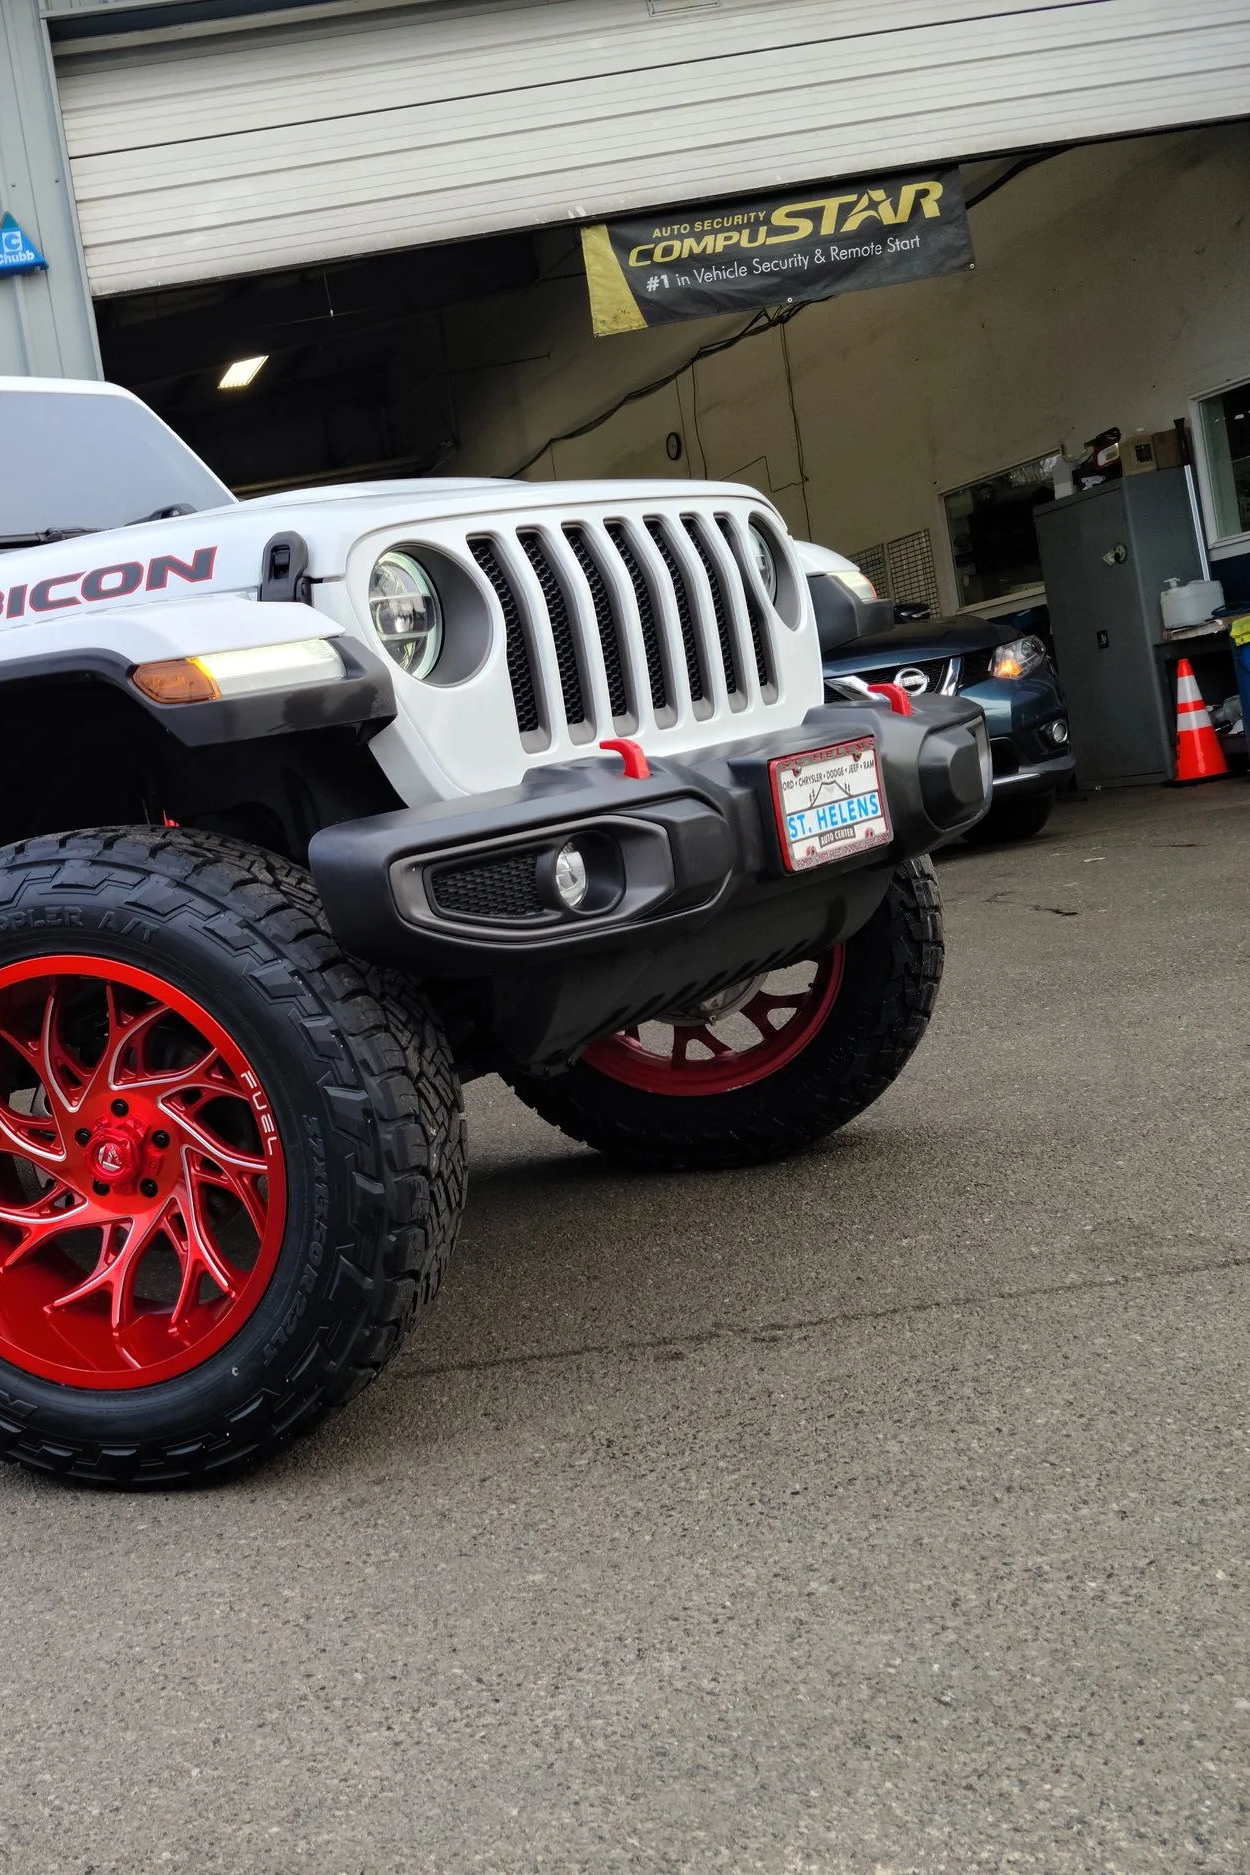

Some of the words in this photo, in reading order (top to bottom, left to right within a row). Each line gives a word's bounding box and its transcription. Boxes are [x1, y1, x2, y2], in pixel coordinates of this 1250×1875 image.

[628, 181, 943, 267] COMPUSTAR
[652, 223, 690, 239] AUTO
[694, 211, 767, 232] SECURITY
[646, 274, 670, 292] #1
[676, 274, 691, 286] in
[694, 262, 748, 284] Vehicle
[753, 253, 809, 274] Security
[814, 249, 826, 264] &
[830, 242, 882, 262] Remote
[887, 235, 920, 253] Start
[813, 739, 874, 761] HELENS
[783, 780, 794, 791] ORD
[799, 772, 823, 787] CHRYSLER
[826, 766, 844, 779] DODGE
[849, 763, 859, 774] JEEP
[863, 759, 874, 769] RAM
[788, 813, 812, 839] ST.
[816, 793, 879, 831] HELENS
[820, 833, 834, 846] AUTO
[834, 827, 854, 840] CENTER
[97, 909, 160, 944] A/T
[240, 1070, 277, 1156] FUEL
